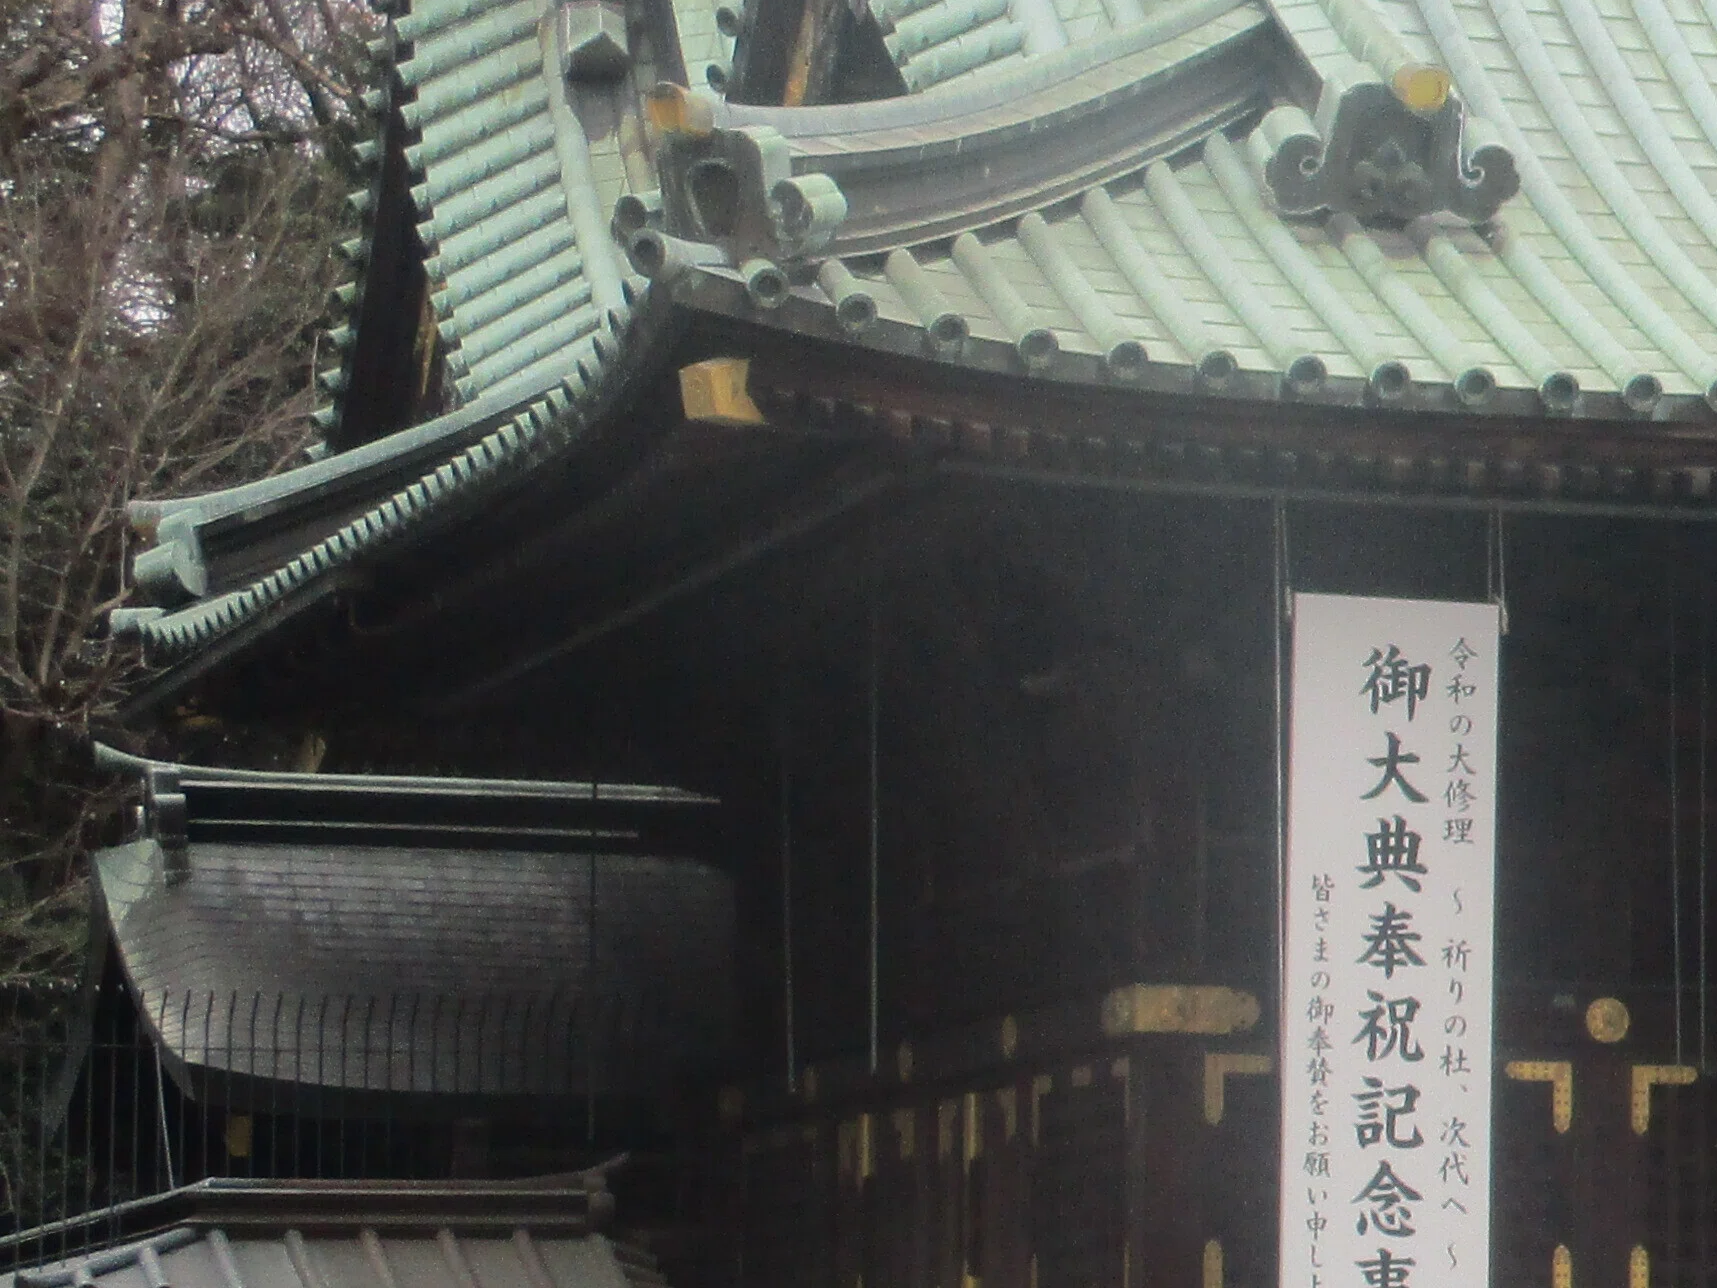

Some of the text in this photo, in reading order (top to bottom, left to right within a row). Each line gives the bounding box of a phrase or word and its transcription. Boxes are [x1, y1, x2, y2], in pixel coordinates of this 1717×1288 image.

[1442, 636, 1480, 846] 令和の大修理
